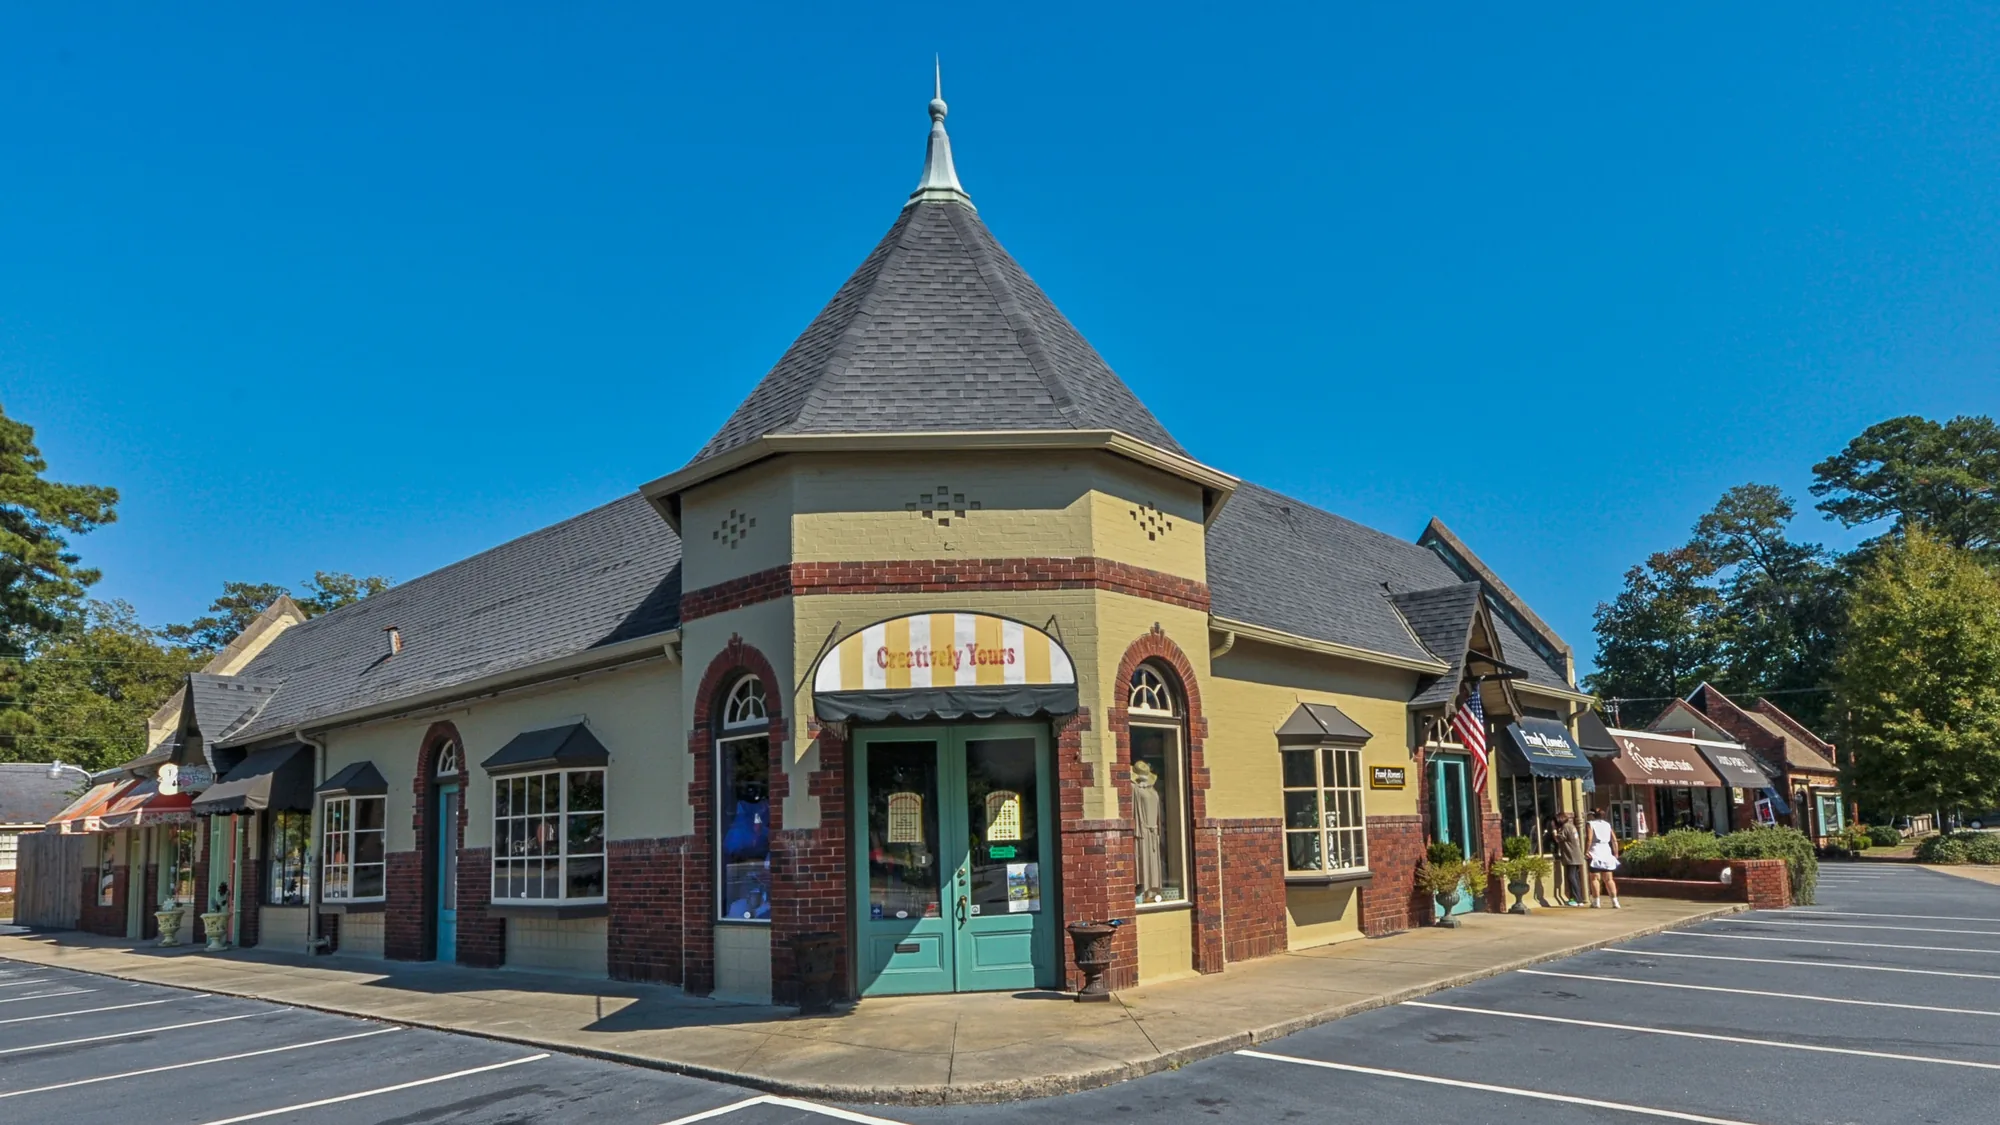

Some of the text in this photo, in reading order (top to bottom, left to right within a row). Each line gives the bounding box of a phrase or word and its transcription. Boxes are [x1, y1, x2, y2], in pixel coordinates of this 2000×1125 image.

[877, 643, 1016, 672] Creatively Yours
[1519, 730, 1547, 749] Frank
[1634, 752, 1662, 772] Quest
[1375, 768, 1388, 779] Frank
